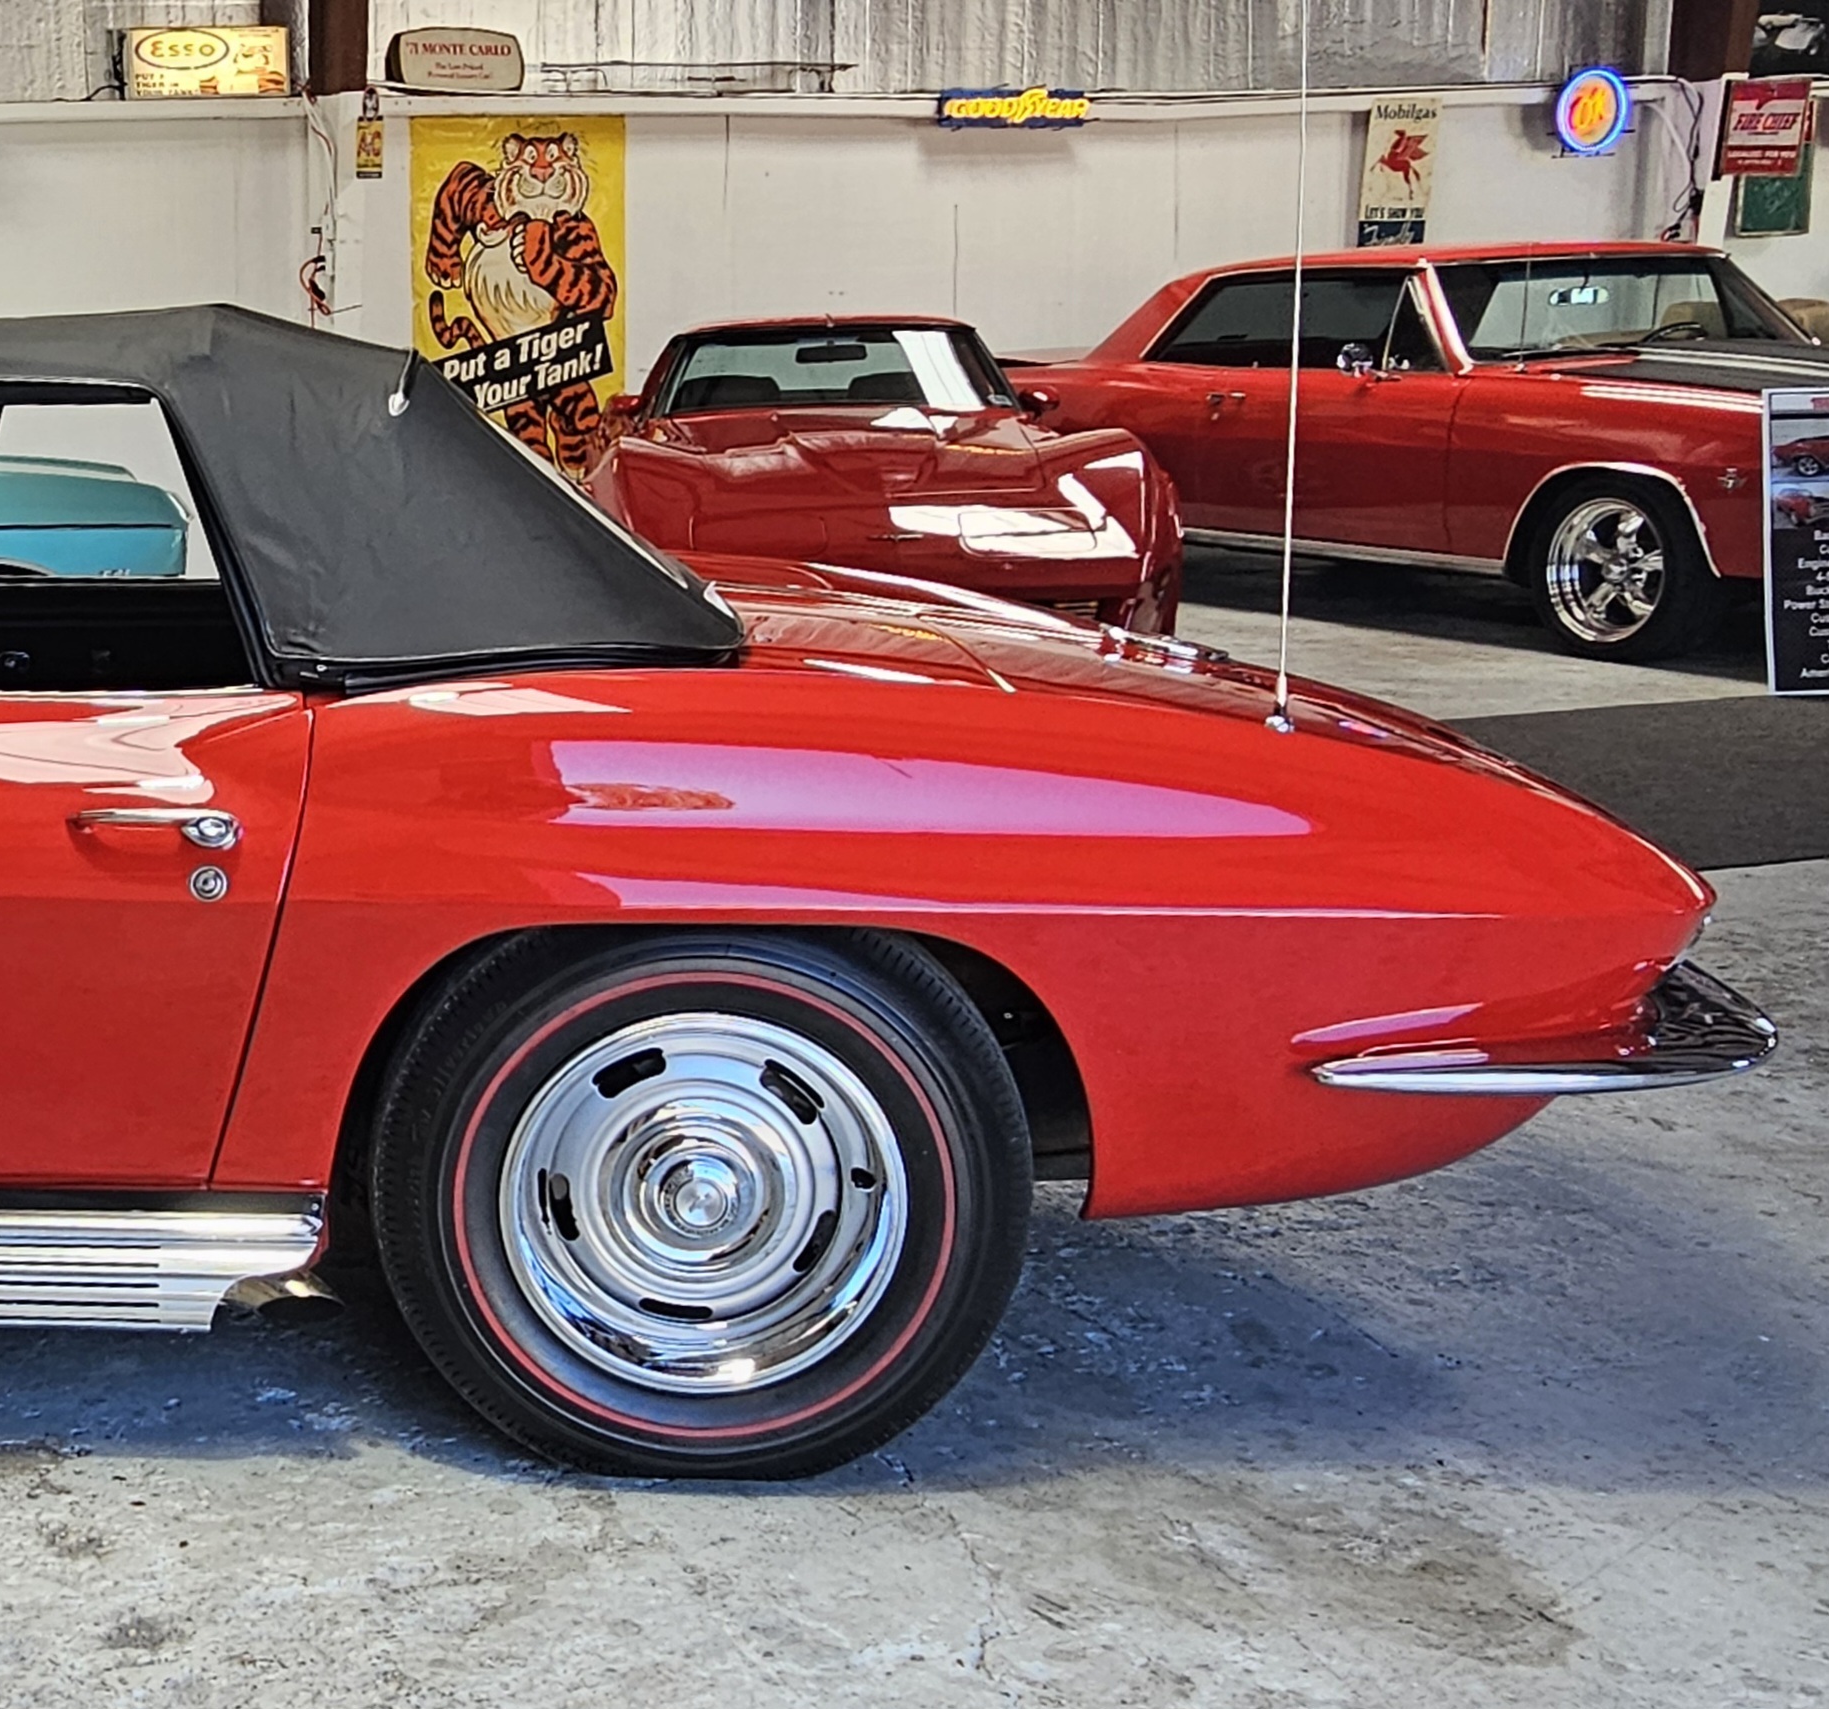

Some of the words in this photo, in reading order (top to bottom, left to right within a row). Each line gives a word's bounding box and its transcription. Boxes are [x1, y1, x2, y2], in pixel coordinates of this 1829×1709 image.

[150, 40, 216, 57] Esso
[421, 43, 467, 56] MONTE
[469, 44, 512, 56] CARLO
[944, 88, 1091, 124] GOODYEAR
[1375, 103, 1438, 124] Mobilgas
[442, 352, 488, 383] Put
[493, 347, 512, 371] a
[515, 321, 591, 364] Tiger
[473, 372, 533, 410] Your
[533, 342, 604, 391] Tank!
[1783, 600, 1817, 610] Power
